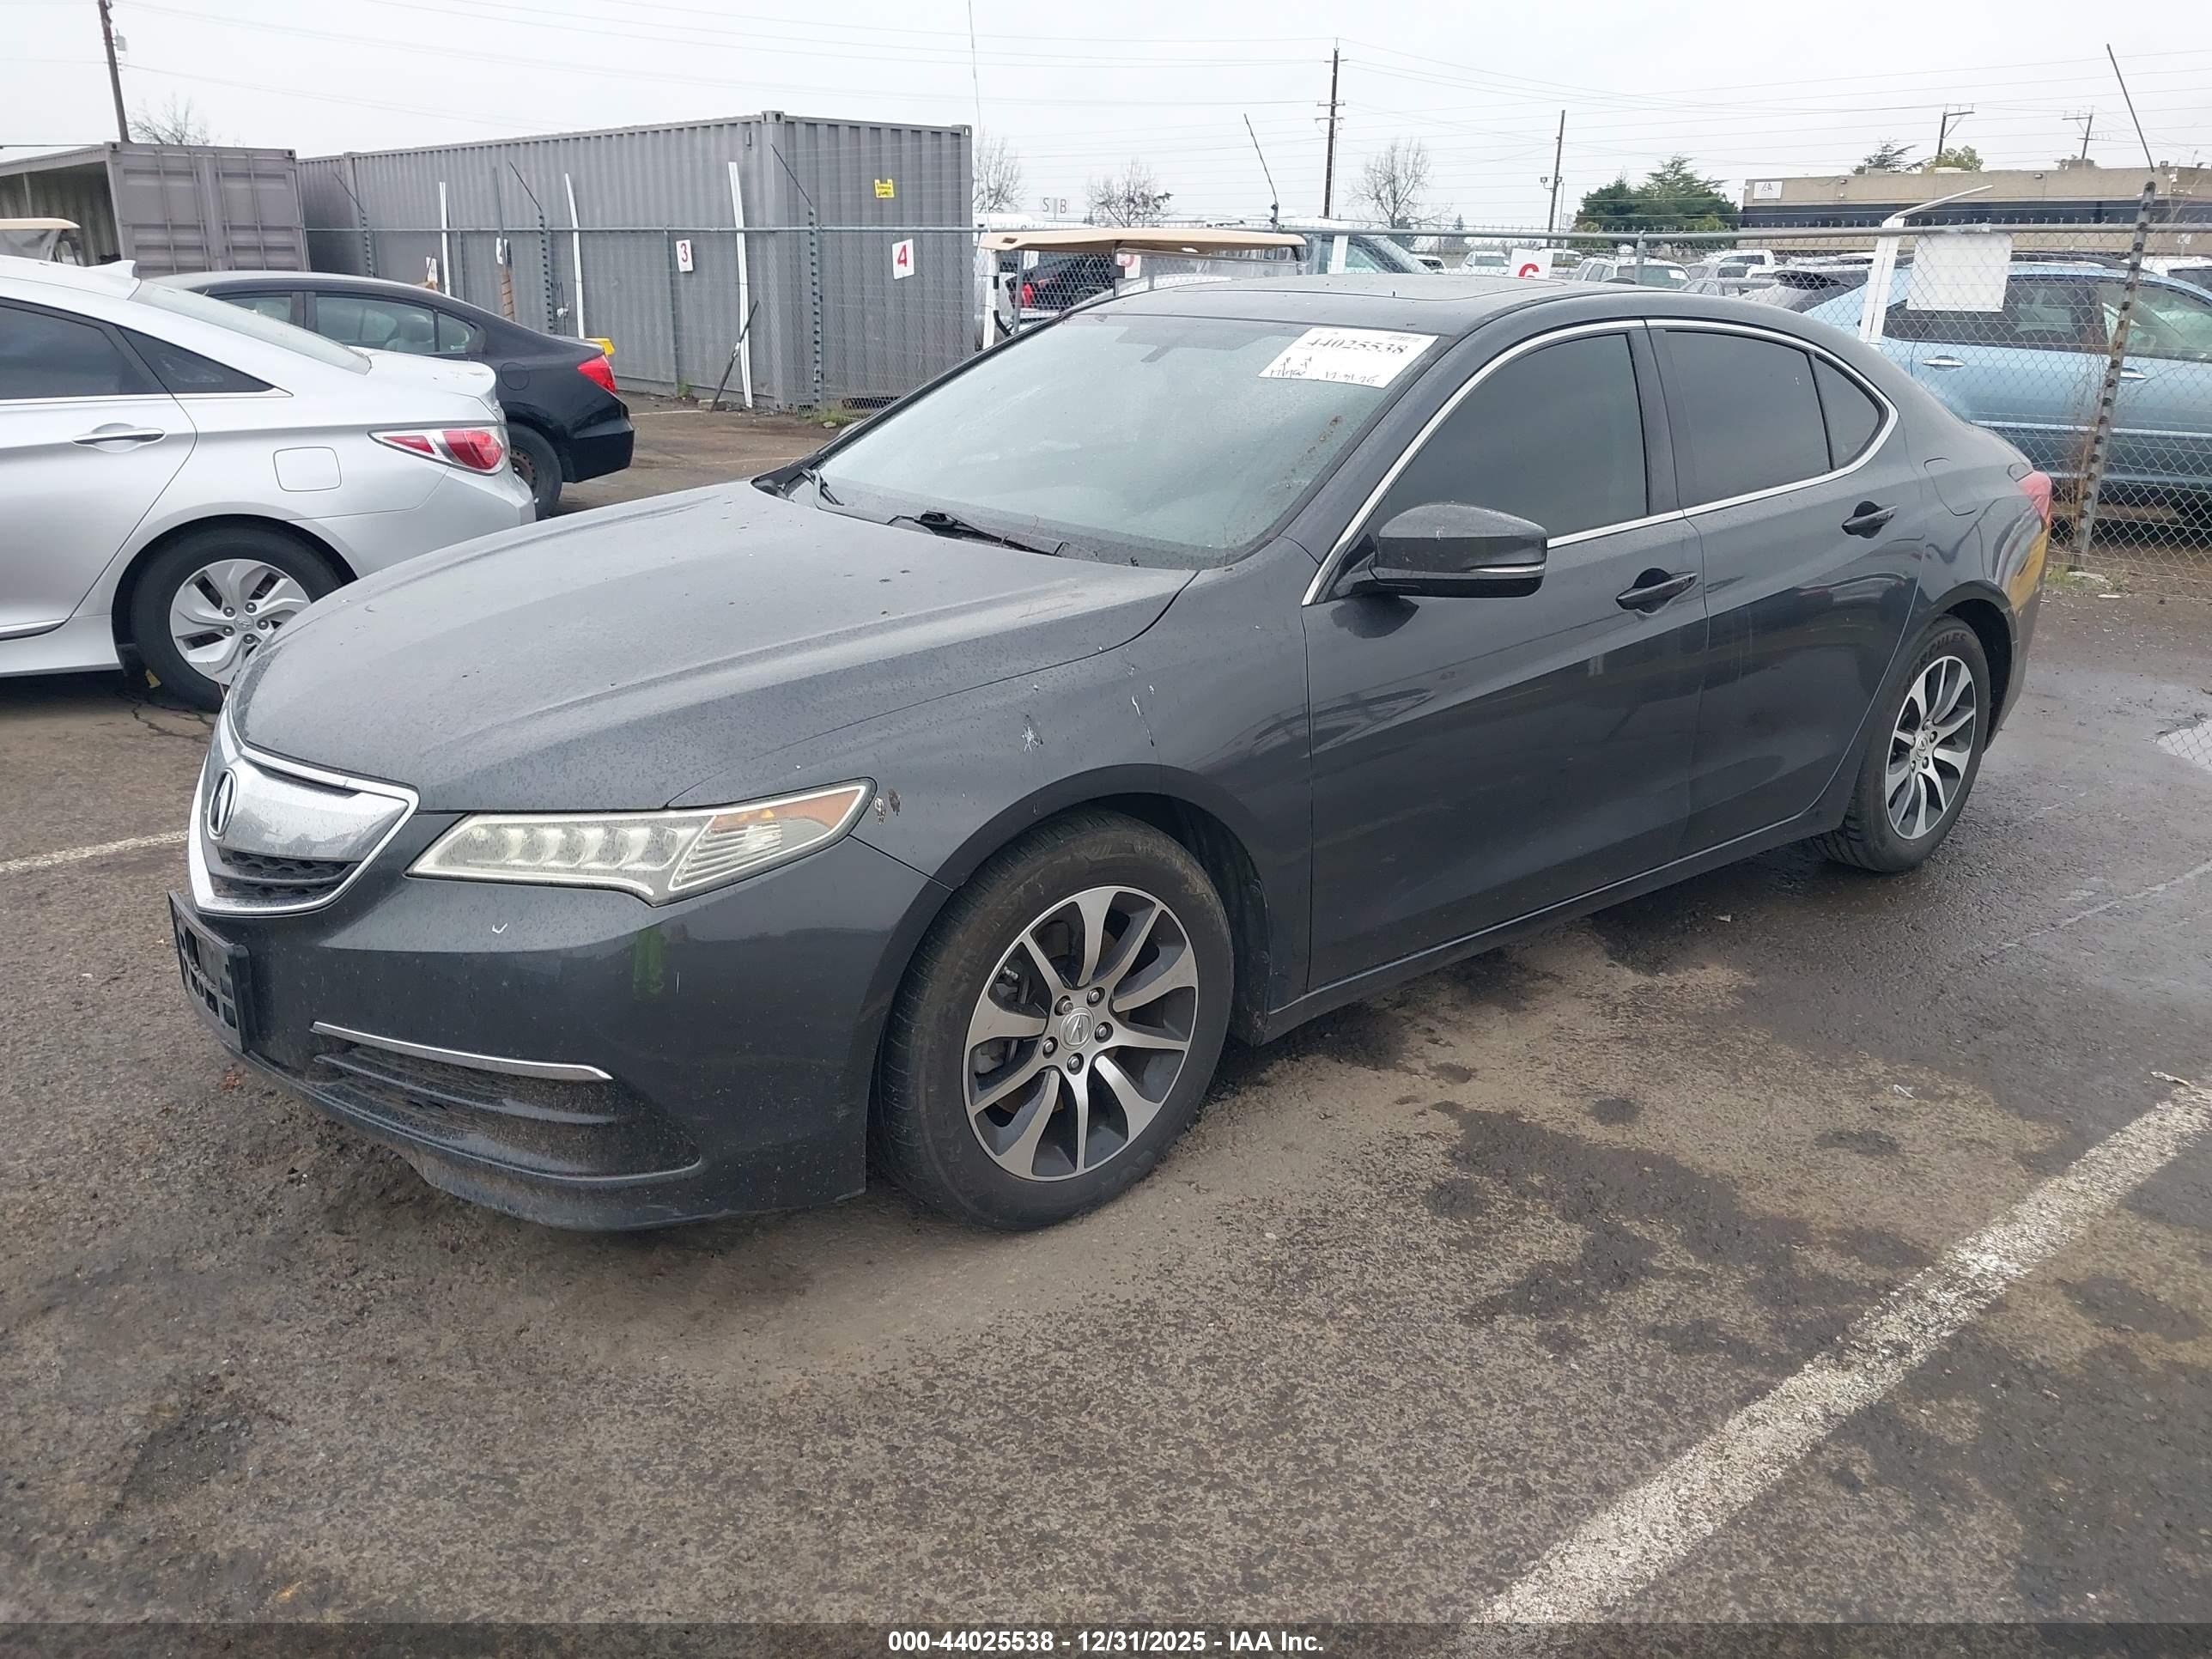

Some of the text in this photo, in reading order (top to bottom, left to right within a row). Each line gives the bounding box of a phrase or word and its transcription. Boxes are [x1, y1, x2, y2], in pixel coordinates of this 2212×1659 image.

[1060, 198, 1066, 213] B
[680, 242, 688, 263] 3
[897, 244, 907, 267] 4
[1307, 337, 1408, 354] 44025538
